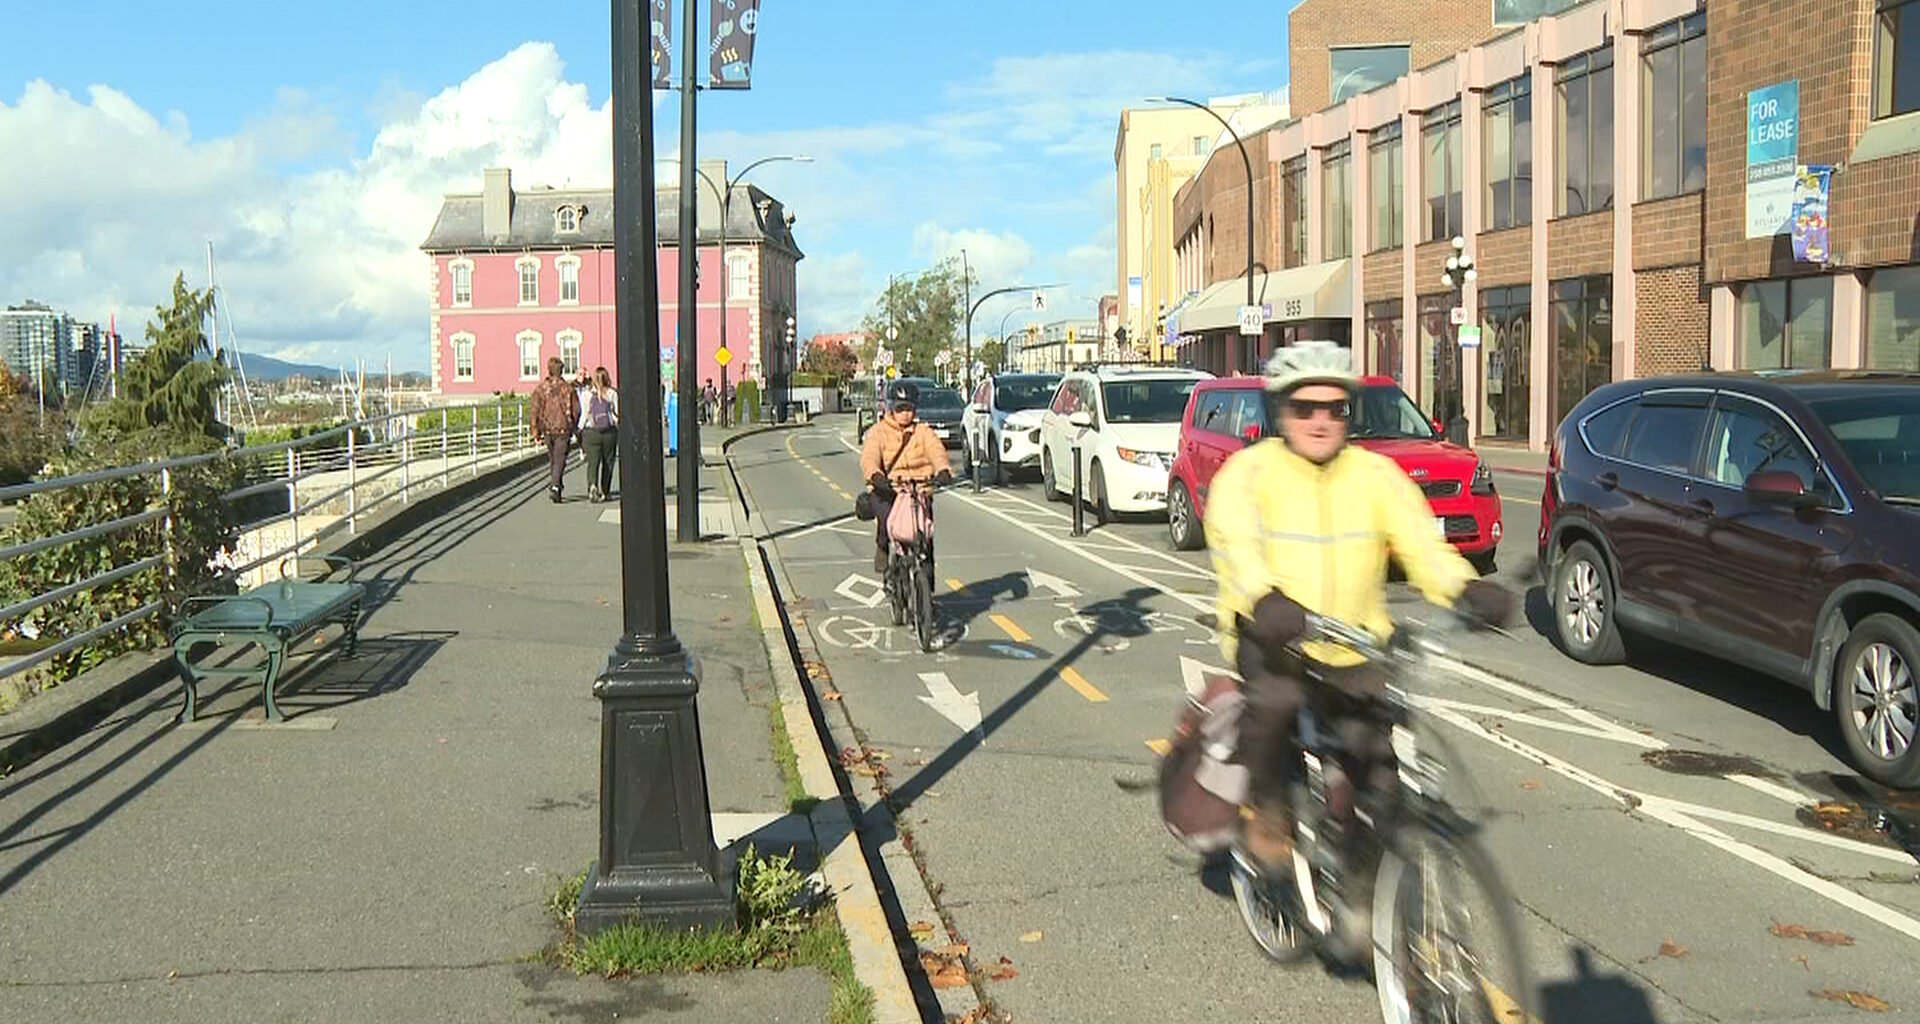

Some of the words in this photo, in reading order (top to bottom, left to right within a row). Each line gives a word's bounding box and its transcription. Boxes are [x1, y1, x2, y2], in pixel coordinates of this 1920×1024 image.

[1751, 99, 1777, 122] FOR
[1751, 119, 1794, 144] LEASE
[1285, 300, 1302, 316] 955
[1243, 314, 1261, 326] 40
